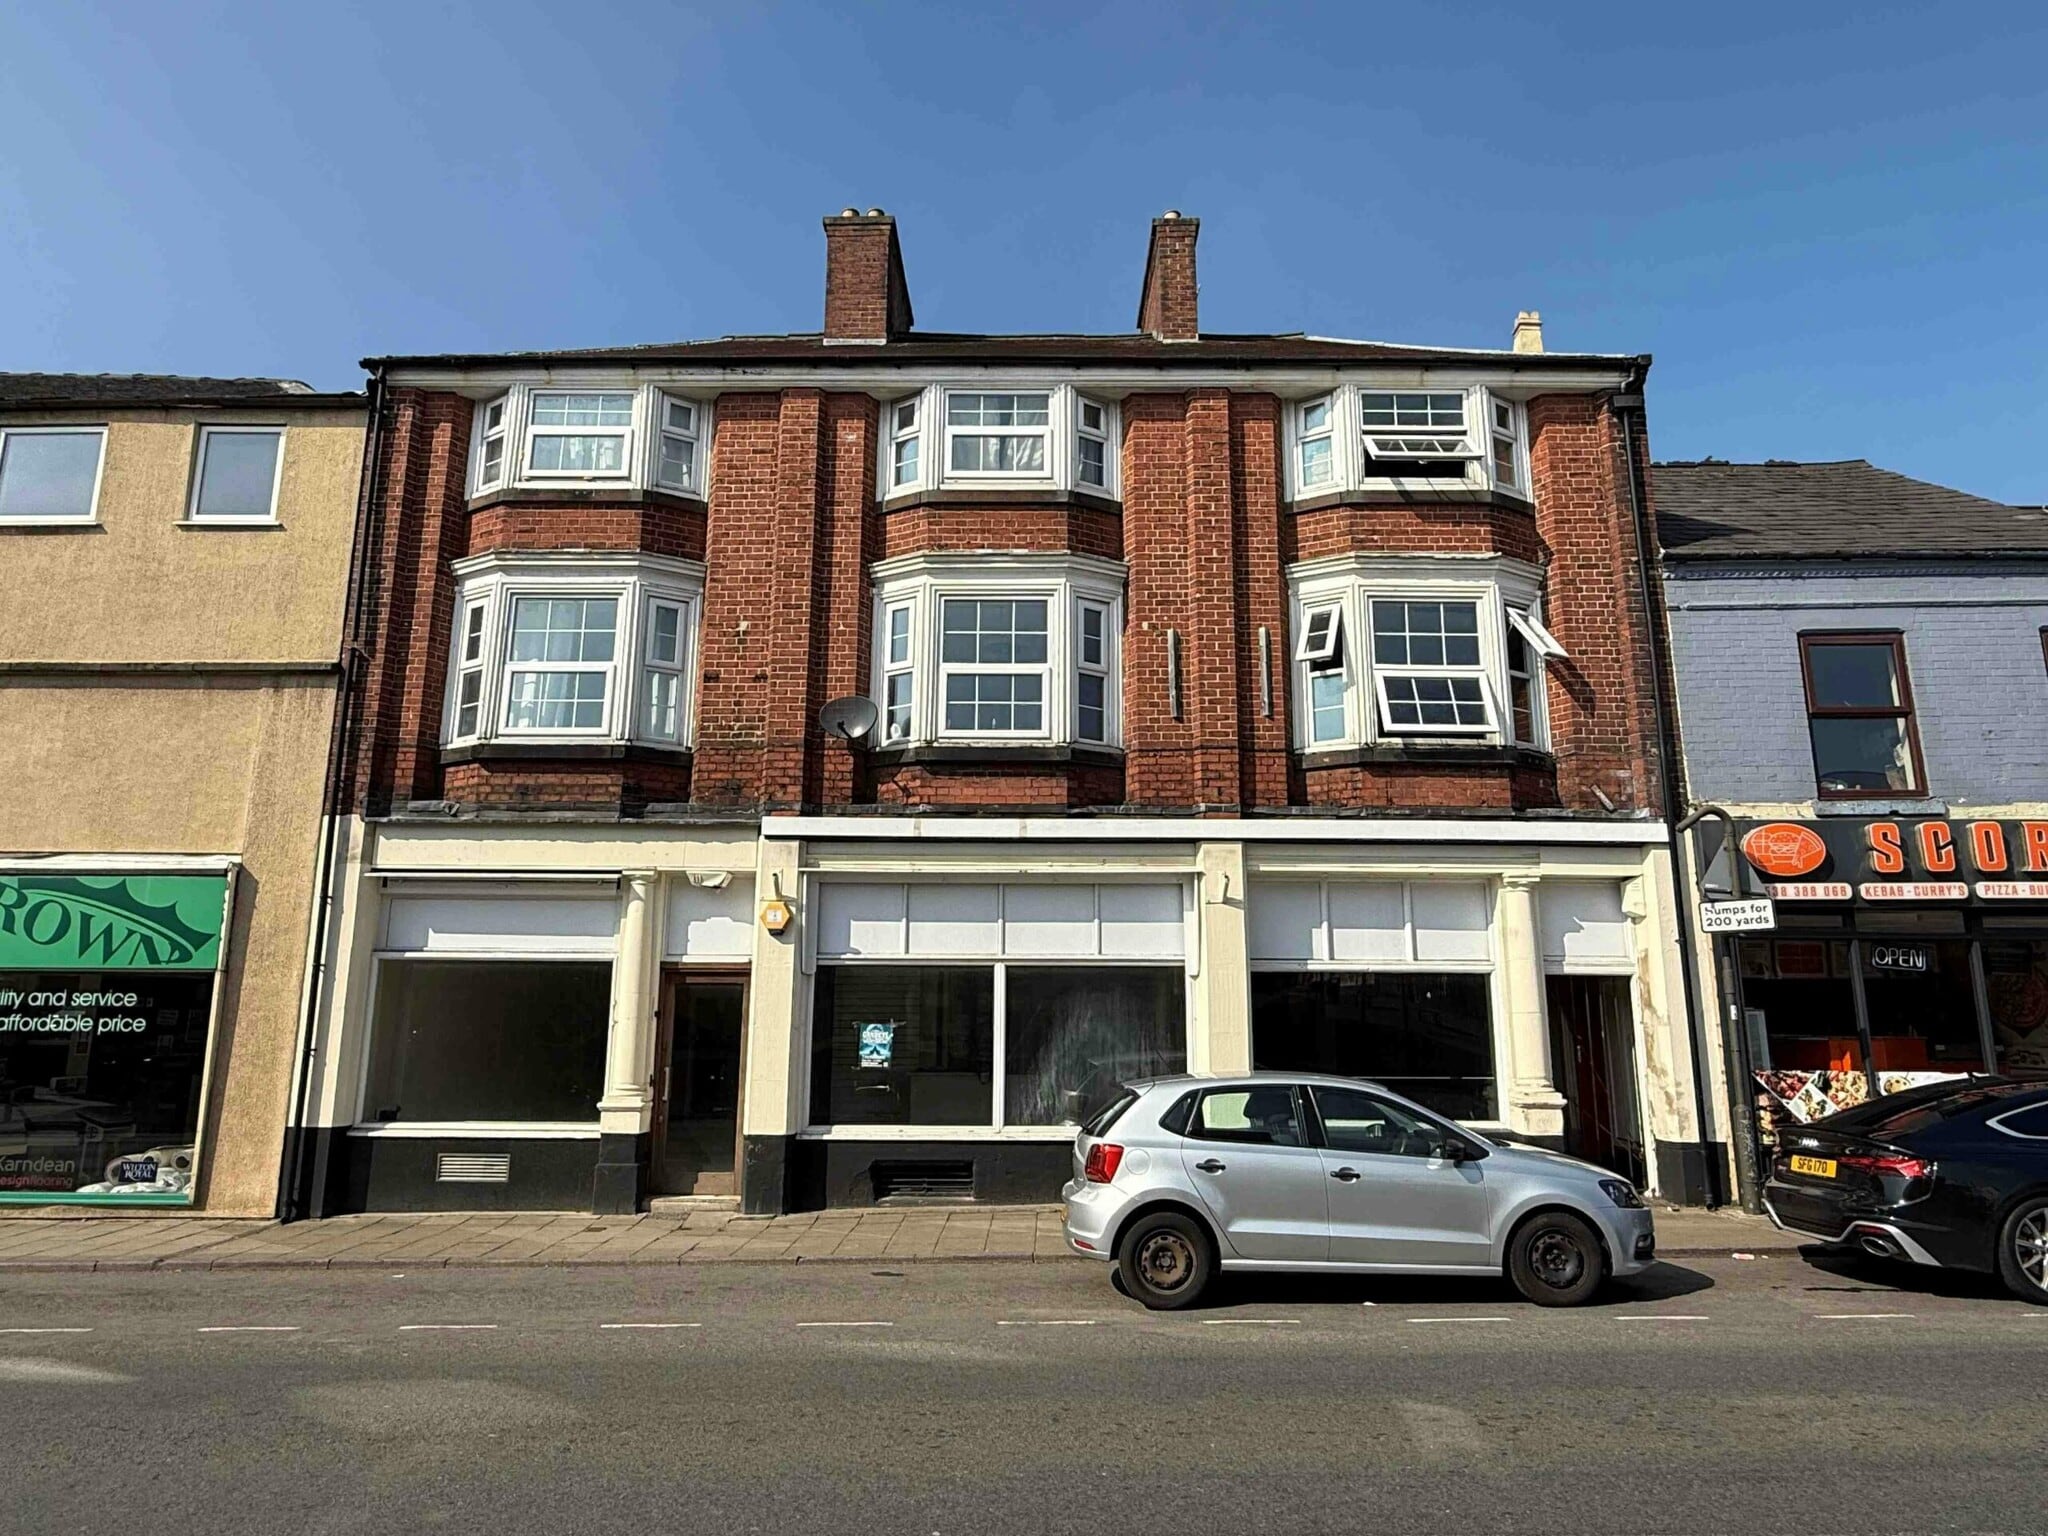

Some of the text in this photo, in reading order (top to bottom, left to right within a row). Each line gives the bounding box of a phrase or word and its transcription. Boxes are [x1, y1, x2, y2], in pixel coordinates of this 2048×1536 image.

[1864, 885, 1904, 897] KEBAB
[1913, 885, 1965, 897] CURRY'S
[1983, 884, 2019, 896] PIZZA
[1751, 903, 1769, 914] for
[1705, 914, 1770, 927] 200 yards
[1874, 946, 1924, 968] OPEN
[28, 988, 67, 1007] and
[71, 988, 138, 1007] service
[0, 1013, 147, 1036] affordable price
